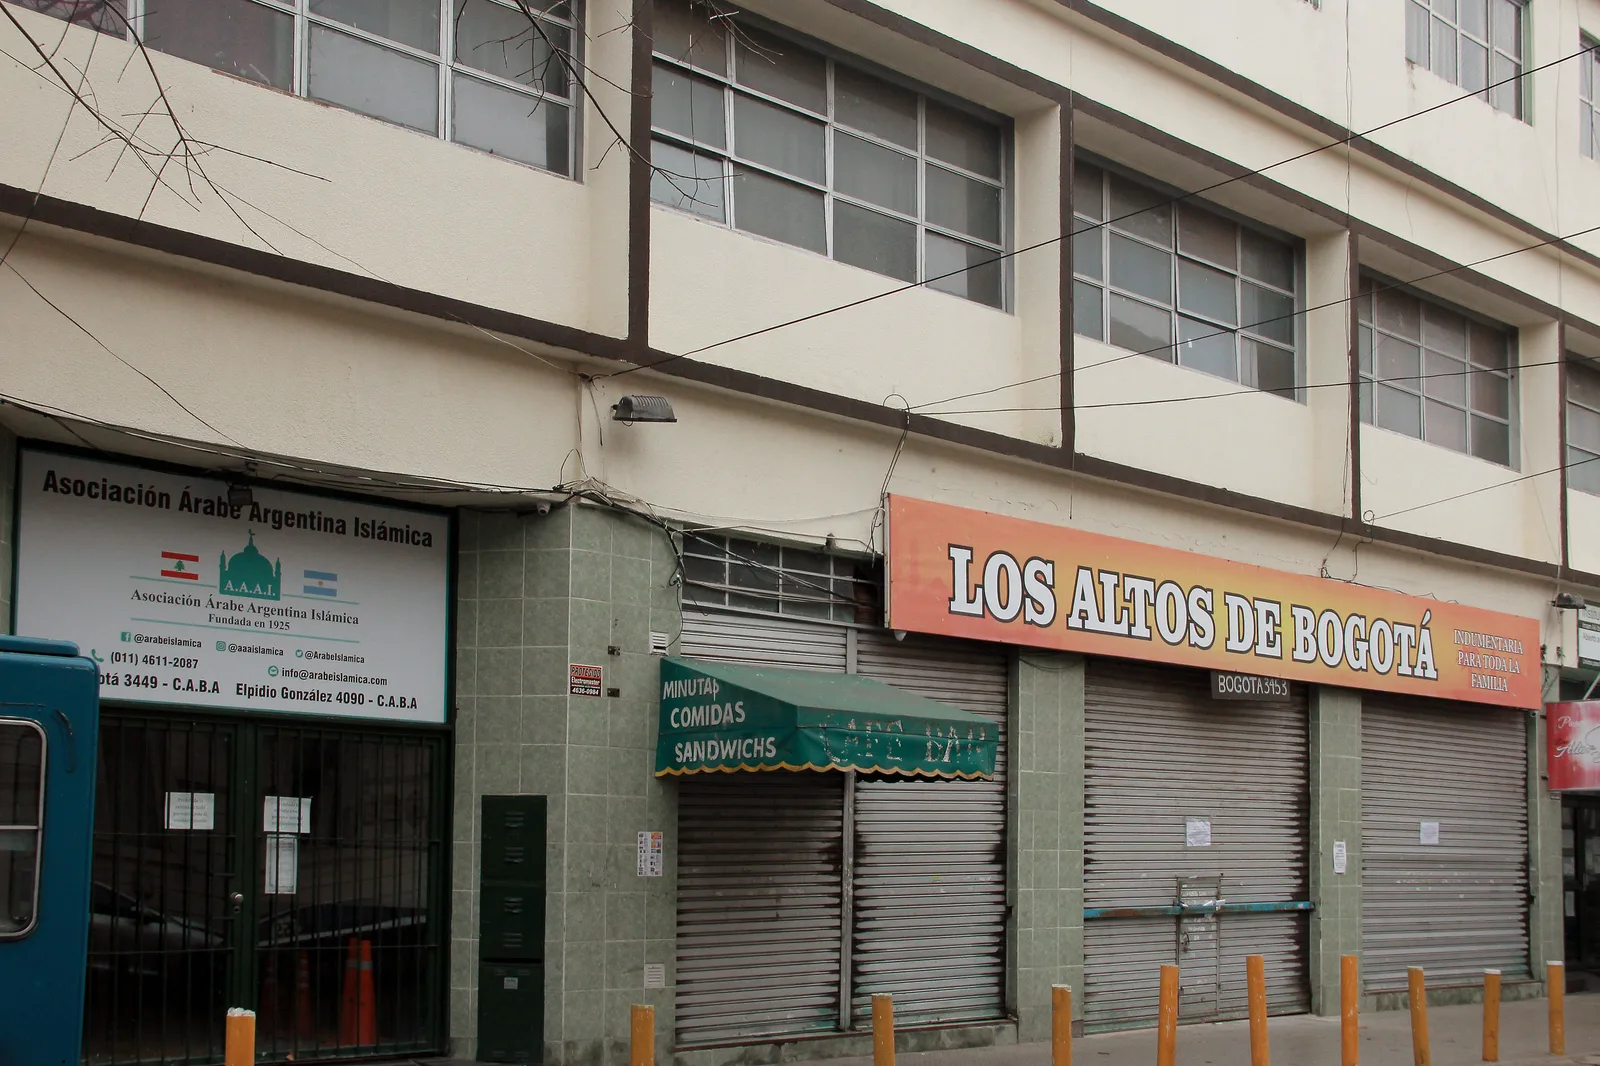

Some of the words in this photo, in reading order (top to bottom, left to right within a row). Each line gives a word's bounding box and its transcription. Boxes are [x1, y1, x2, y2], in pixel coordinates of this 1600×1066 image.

[43, 470, 171, 509] Asociación
[178, 486, 241, 520] Árabe
[248, 501, 346, 535] Argentina
[354, 516, 432, 547] Islámica
[224, 580, 276, 597] A.A.A.I.
[131, 589, 201, 607] Asociación
[205, 593, 244, 612] Árabe
[247, 602, 307, 619] Argentina
[311, 608, 359, 625] Islámica
[948, 543, 1056, 628] LOS
[1066, 565, 1215, 650] ALTOS
[1224, 591, 1283, 659] DE
[1290, 604, 1438, 681] BOGOTÁ
[209, 613, 251, 627] Fundada
[254, 620, 265, 628] en
[269, 620, 290, 631] 1925
[134, 633, 202, 648] @arabeislamica
[228, 643, 284, 656] @aaaislamica
[1453, 629, 1524, 655] INDUMENTARIA
[111, 652, 139, 666] (011)
[142, 655, 199, 669] 4611-2087
[1458, 651, 1482, 668] PARA
[1483, 655, 1508, 672] TODA
[1508, 659, 1520, 674] LA
[281, 668, 388, 686] info@arabeislamica.com
[571, 667, 601, 678] PROTEGIDO
[1471, 673, 1508, 692] FAMILIA
[124, 674, 158, 689] 3449
[173, 678, 220, 694] C.A.B.A
[236, 683, 277, 699] Elpidio
[281, 686, 332, 703] González
[336, 691, 365, 705] 4090
[377, 694, 417, 709] C.A.B.A
[670, 701, 745, 729] COMIDAS
[675, 736, 776, 763] SANDWICHS
